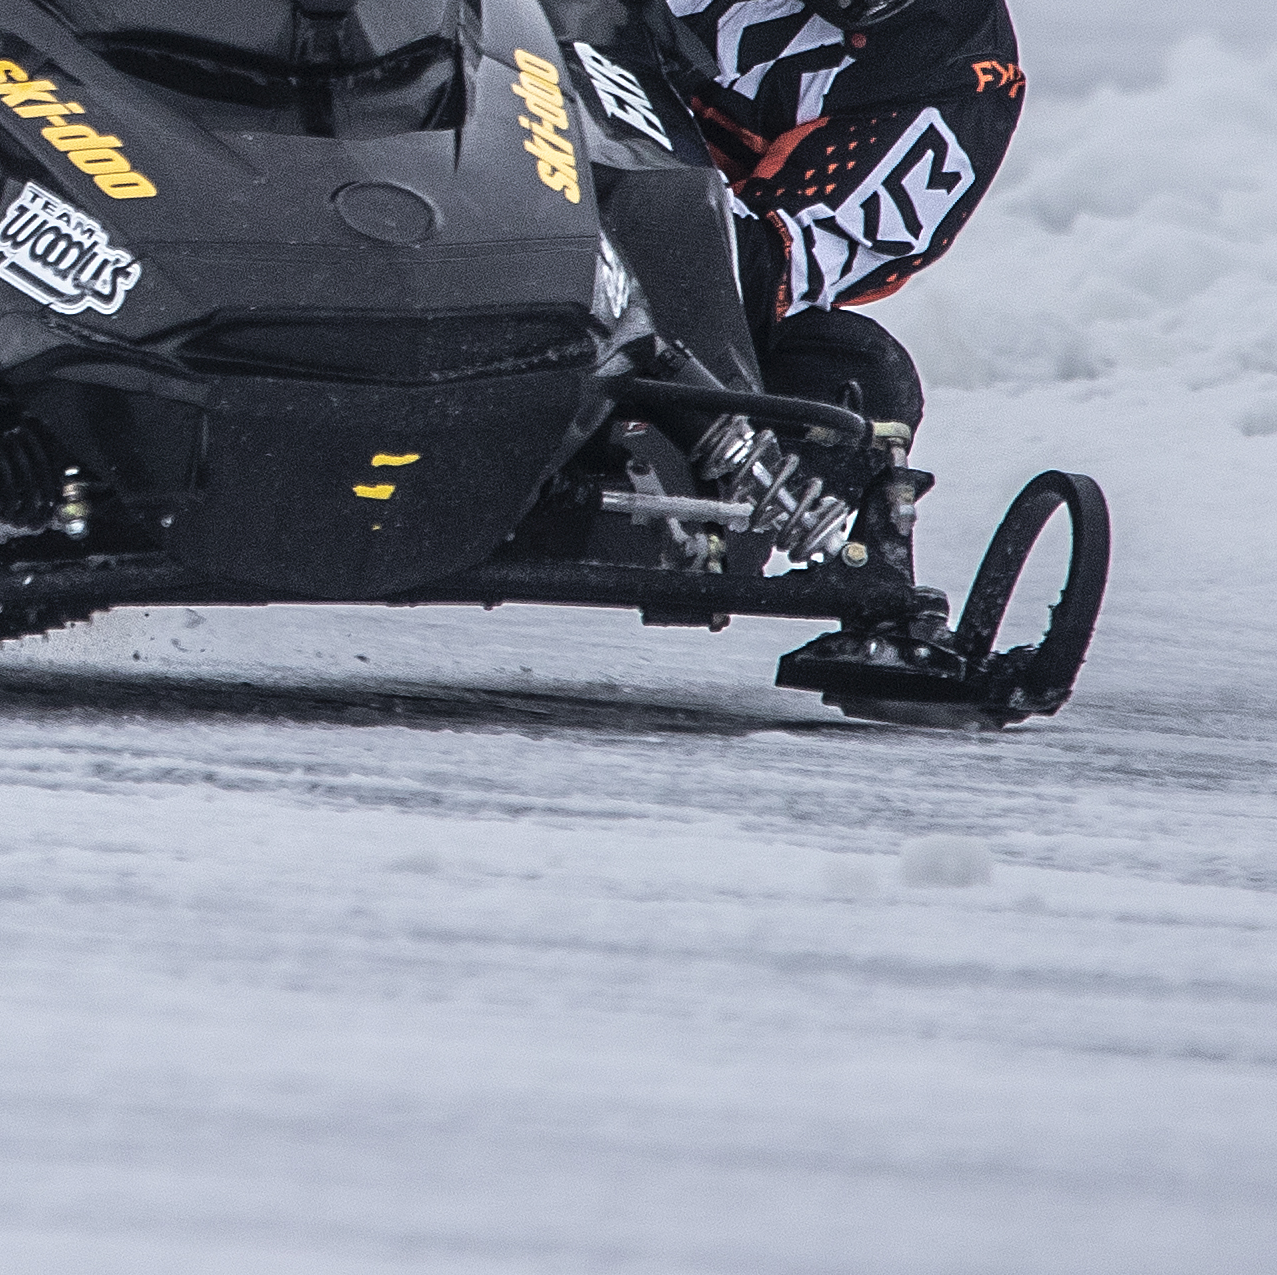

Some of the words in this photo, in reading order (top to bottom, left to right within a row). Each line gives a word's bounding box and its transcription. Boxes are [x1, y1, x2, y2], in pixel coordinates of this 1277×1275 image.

[511, 48, 581, 204] ski-doo
[573, 41, 674, 152] FXR
[28, 190, 96, 241] TEAM
